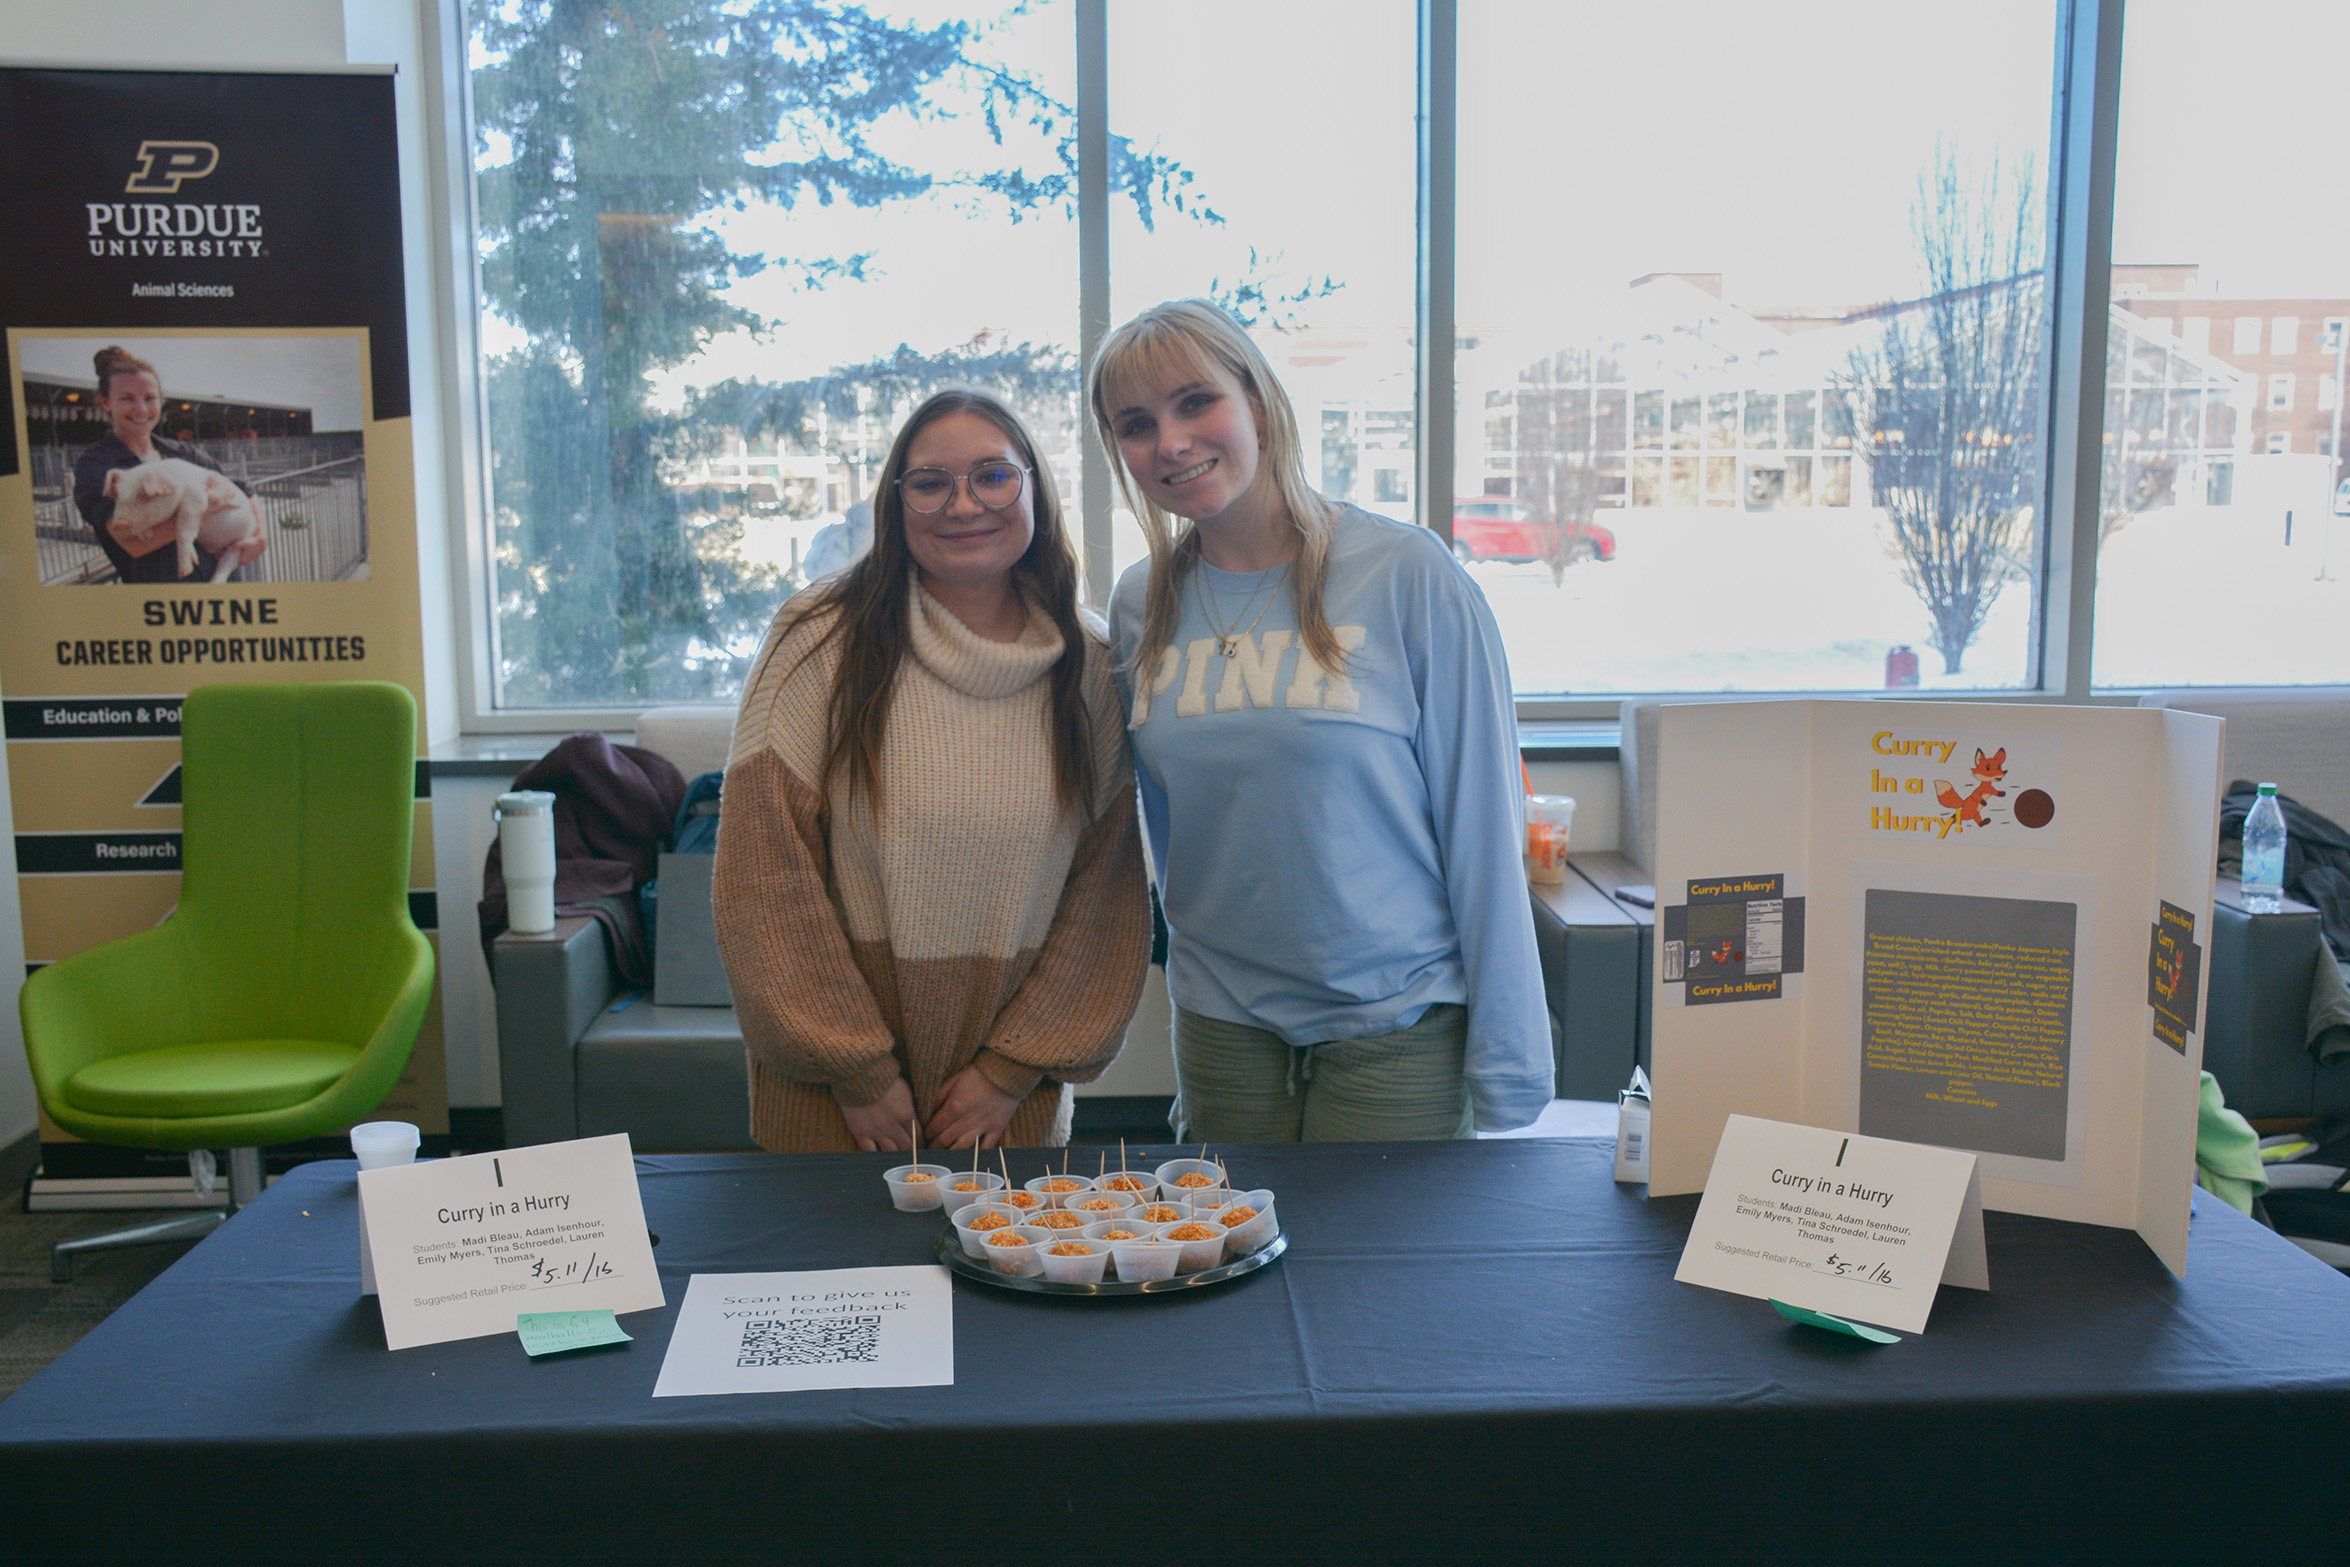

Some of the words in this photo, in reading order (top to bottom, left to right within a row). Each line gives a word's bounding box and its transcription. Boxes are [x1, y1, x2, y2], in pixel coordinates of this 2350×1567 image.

[125, 141, 220, 193] P
[86, 203, 263, 238] PURDUE
[89, 240, 264, 257] UNIVERSITY
[132, 283, 175, 297] Animal
[178, 283, 234, 297] Sciences
[143, 599, 279, 626] SWINE
[57, 641, 152, 666] CAREER
[160, 636, 365, 663] OPPORTUNITIES
[1127, 625, 1367, 731] PINK
[43, 708, 132, 725] Education
[136, 707, 150, 723] &
[155, 707, 182, 722] Pol
[1871, 731, 1957, 764] Curry
[1871, 769, 1898, 793] In
[1904, 777, 1924, 794] a
[1870, 806, 1964, 839] Hurry!
[96, 843, 177, 859] Research
[1691, 884, 1721, 896] Curry
[1722, 883, 1732, 893] In
[1743, 879, 1775, 893] Hurry!
[2158, 928, 2175, 954] Curry
[1692, 985, 1722, 997] Curry
[1724, 984, 1733, 994] In
[1744, 979, 1777, 993] Hurry!
[1771, 1168, 1814, 1193] Curry
[1817, 1177, 1832, 1193] in
[1835, 1184, 1845, 1196] a
[1849, 1183, 1894, 1208] Hurry
[438, 1205, 485, 1224] Curry
[490, 1202, 506, 1217] in
[510, 1201, 520, 1214] a
[524, 1193, 571, 1212] Hurry
[1737, 1193, 1777, 1210] Students:
[1779, 1202, 1803, 1215] Madi
[1804, 1206, 1834, 1221] Bleau,
[1836, 1213, 1865, 1227] Adam
[1866, 1218, 1912, 1237] Isenhour,
[413, 1239, 459, 1255] Students:
[462, 1234, 488, 1247] Madi
[490, 1230, 523, 1243] Bleau,
[525, 1225, 555, 1238] Adam
[557, 1218, 605, 1233] Isenhour,
[1735, 1205, 1762, 1220] Emily
[1763, 1210, 1794, 1225] Myers,
[1797, 1217, 1817, 1229] Tina
[1818, 1222, 1870, 1240] Schroedel,
[1872, 1232, 1906, 1246] Lauren
[1797, 1229, 1835, 1245] Thomas
[417, 1253, 447, 1266] Emily
[449, 1248, 485, 1262] Myers,
[487, 1243, 510, 1255] Tina
[512, 1235, 568, 1252] Schroedel,
[569, 1230, 605, 1243] Lauren
[494, 1252, 536, 1266] Thomas
[1714, 1241, 1760, 1259] Suggested
[1762, 1250, 1788, 1263] Retail
[1789, 1256, 1815, 1270] Price:
[414, 1291, 468, 1308] Suggested
[470, 1285, 499, 1299] Retail
[501, 1281, 529, 1294] Price:
[723, 1295, 780, 1305] Scan
[791, 1293, 815, 1302] to
[823, 1289, 875, 1301] give
[884, 1289, 911, 1297] us
[723, 1309, 779, 1319] your
[791, 1302, 907, 1315] feedback
